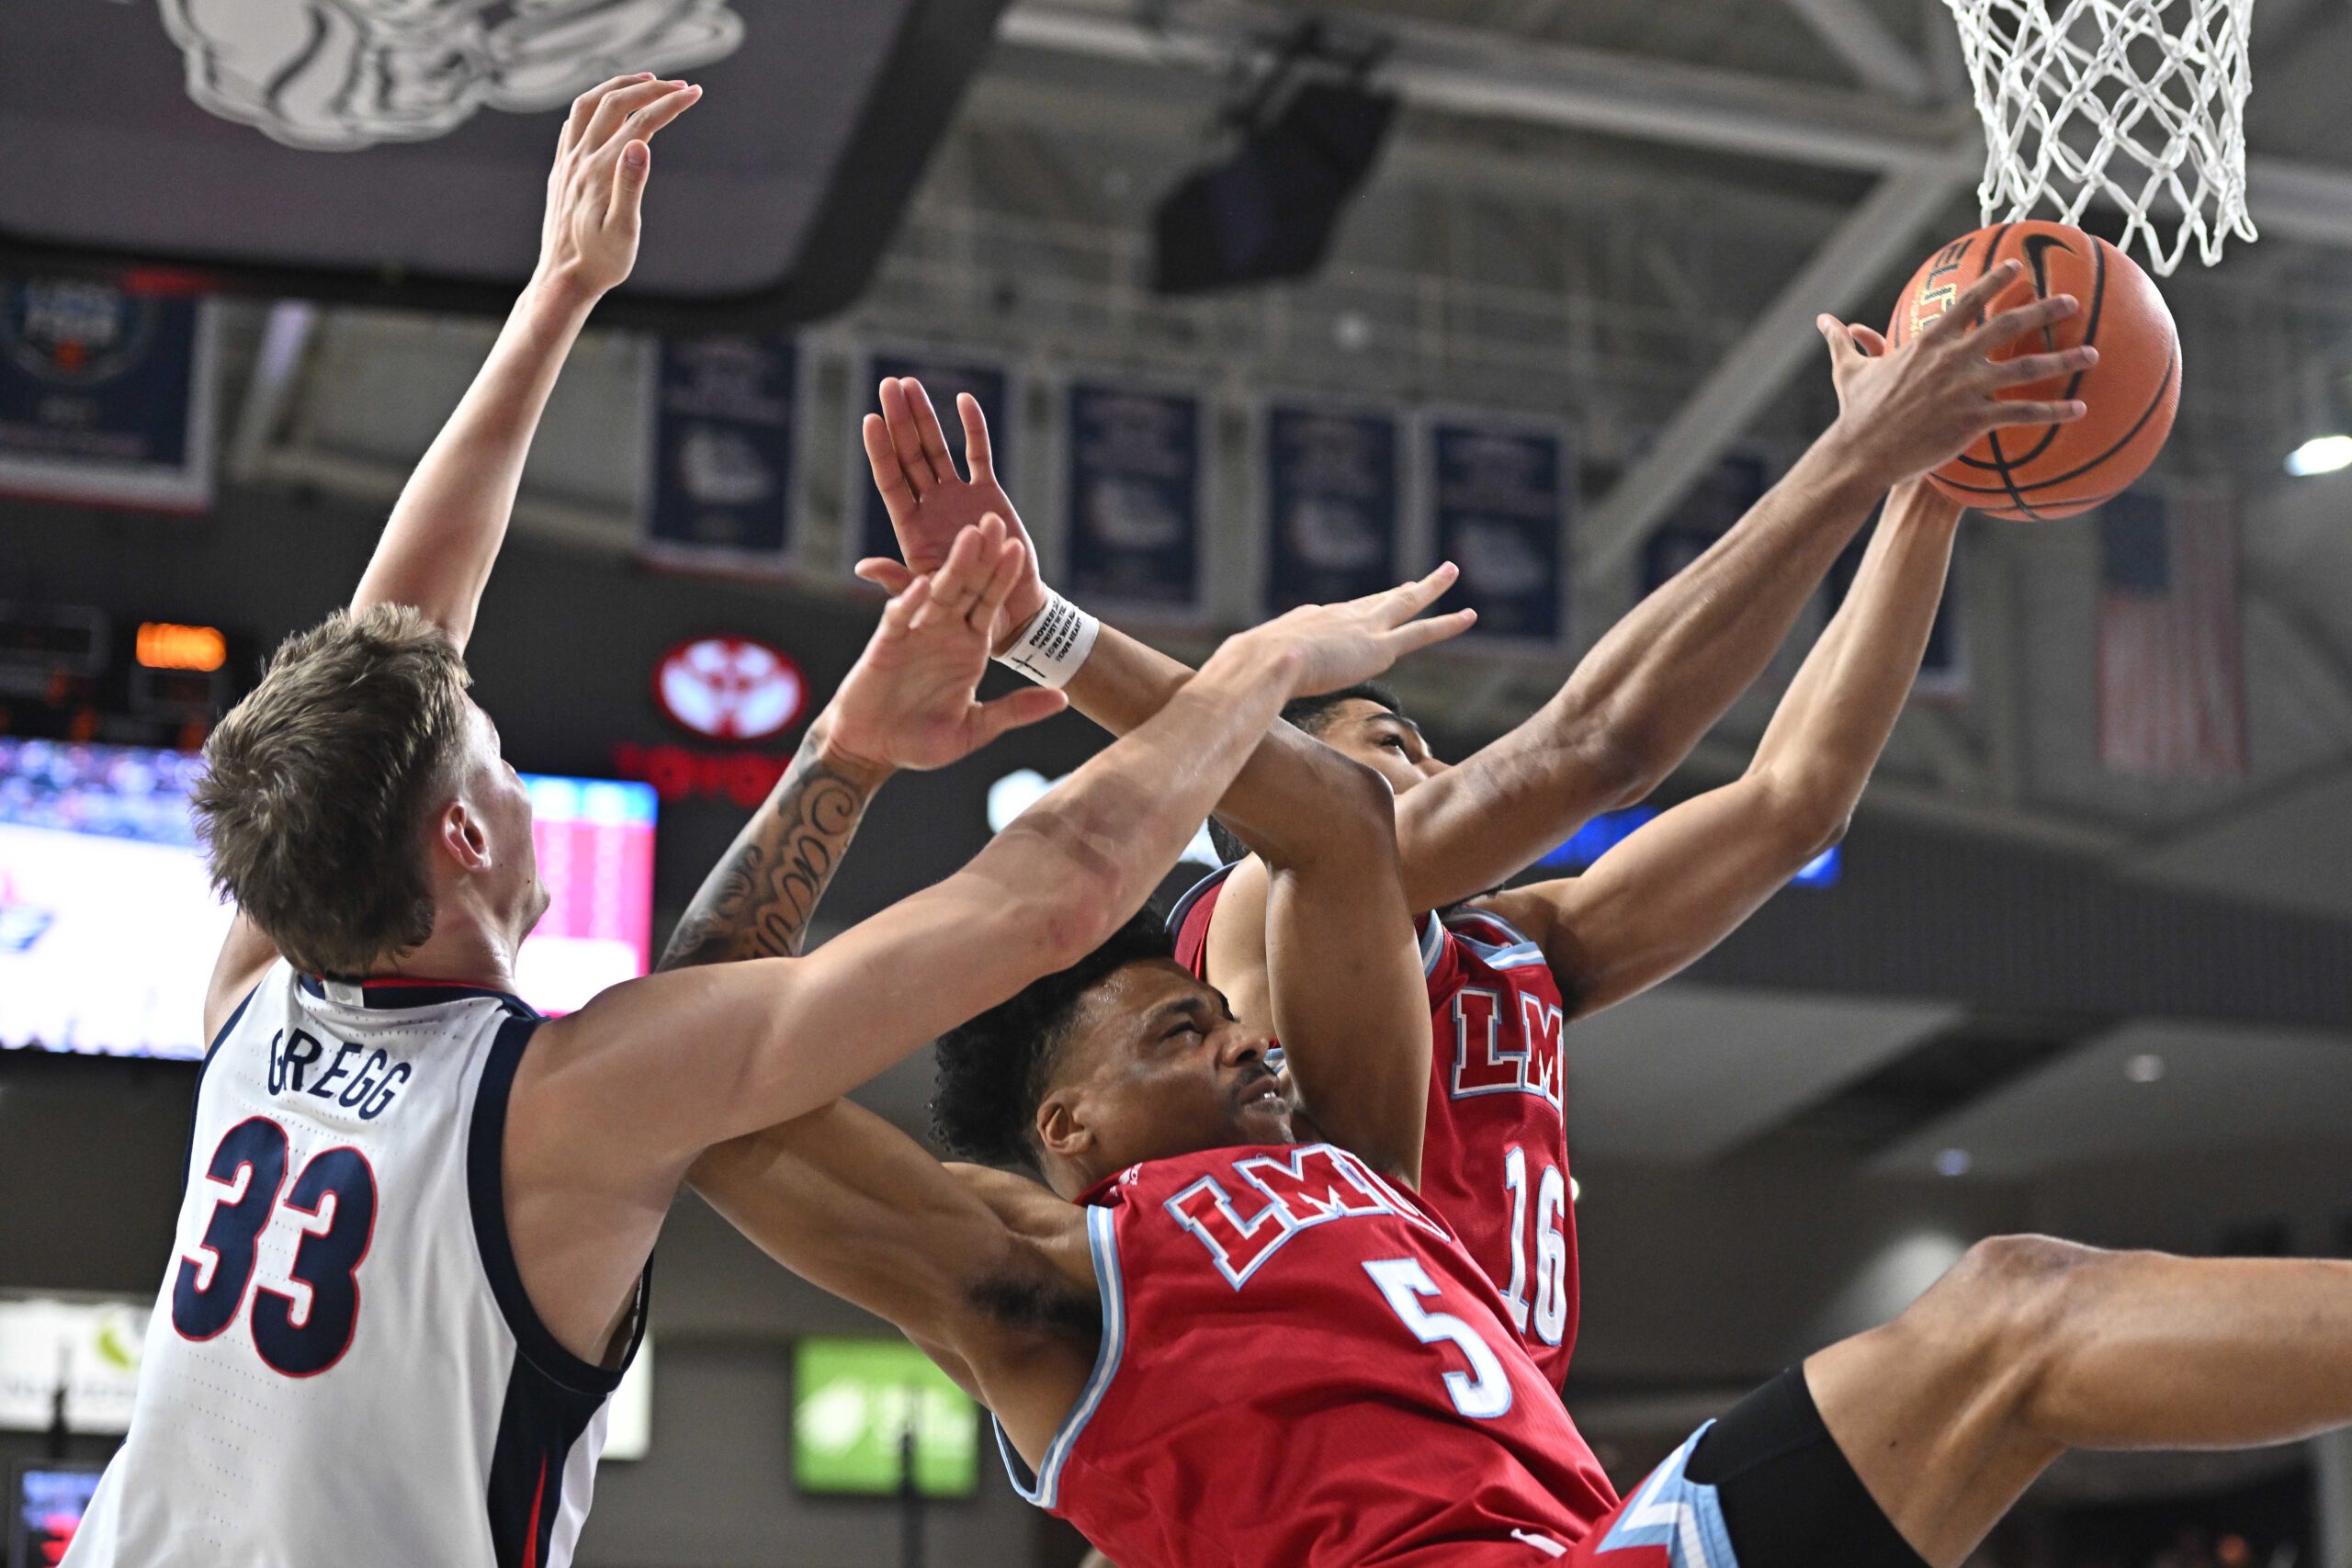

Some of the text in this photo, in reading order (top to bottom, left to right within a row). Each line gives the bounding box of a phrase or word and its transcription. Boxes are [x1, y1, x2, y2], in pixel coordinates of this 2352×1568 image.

[1045, 637, 1062, 658] LORD
[1059, 618, 1072, 637] WITH
[1055, 641, 1072, 661] YOUR
[267, 1027, 412, 1120] GREGG
[1450, 986, 1564, 1122] LM
[171, 1114, 379, 1379] 33
[1499, 1146, 1566, 1347] 16
[1361, 1258, 1513, 1419] 5
